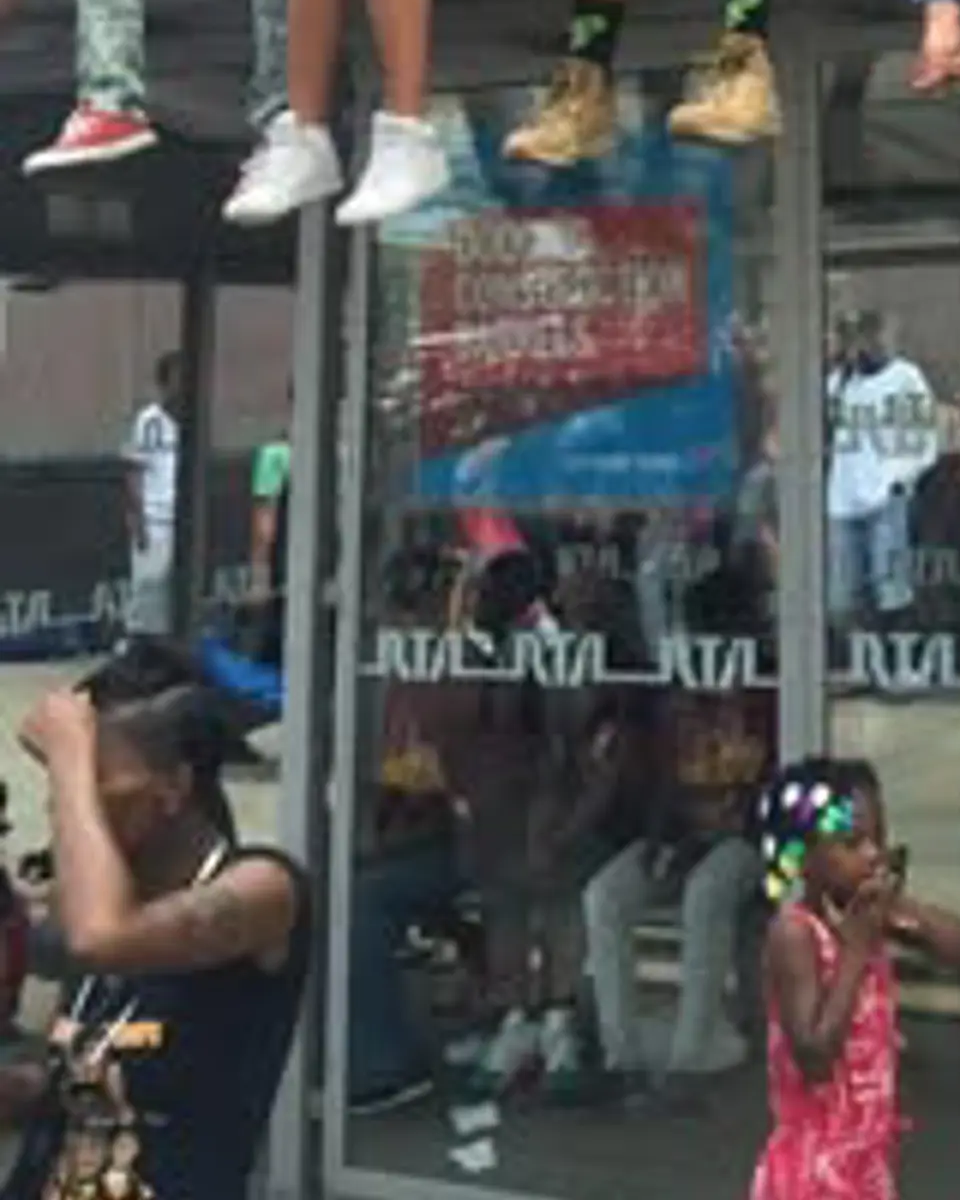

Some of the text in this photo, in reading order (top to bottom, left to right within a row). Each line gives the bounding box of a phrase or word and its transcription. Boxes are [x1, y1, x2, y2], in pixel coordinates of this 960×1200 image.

[0, 589, 51, 636] TA
[376, 627, 462, 682] RTA
[514, 631, 603, 687] RTA
[660, 635, 758, 689] RTA
[849, 632, 956, 689] RTA
